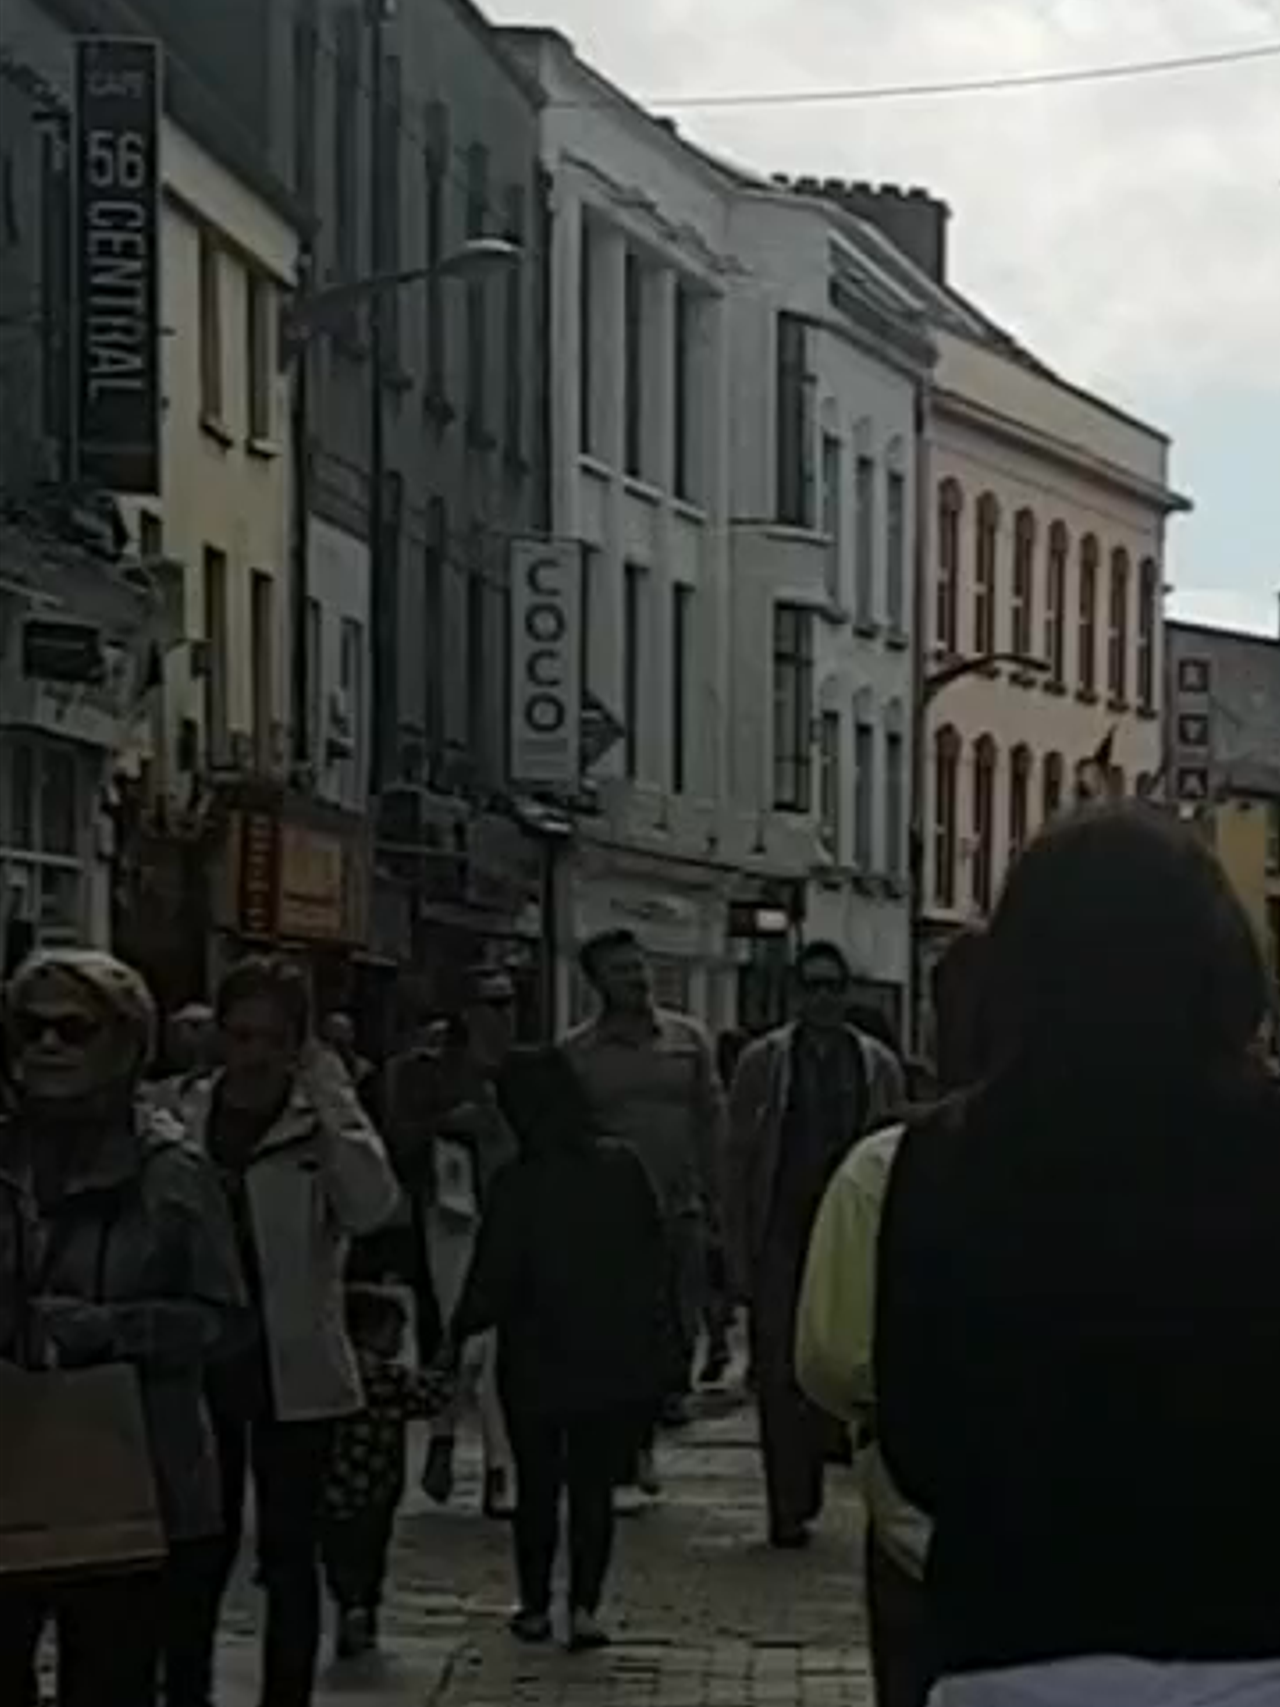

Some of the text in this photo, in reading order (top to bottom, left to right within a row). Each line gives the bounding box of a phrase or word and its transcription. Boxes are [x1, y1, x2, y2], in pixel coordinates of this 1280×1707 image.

[87, 130, 146, 189] 56
[86, 200, 149, 401] CENTRAL
[525, 558, 565, 733] COCO
